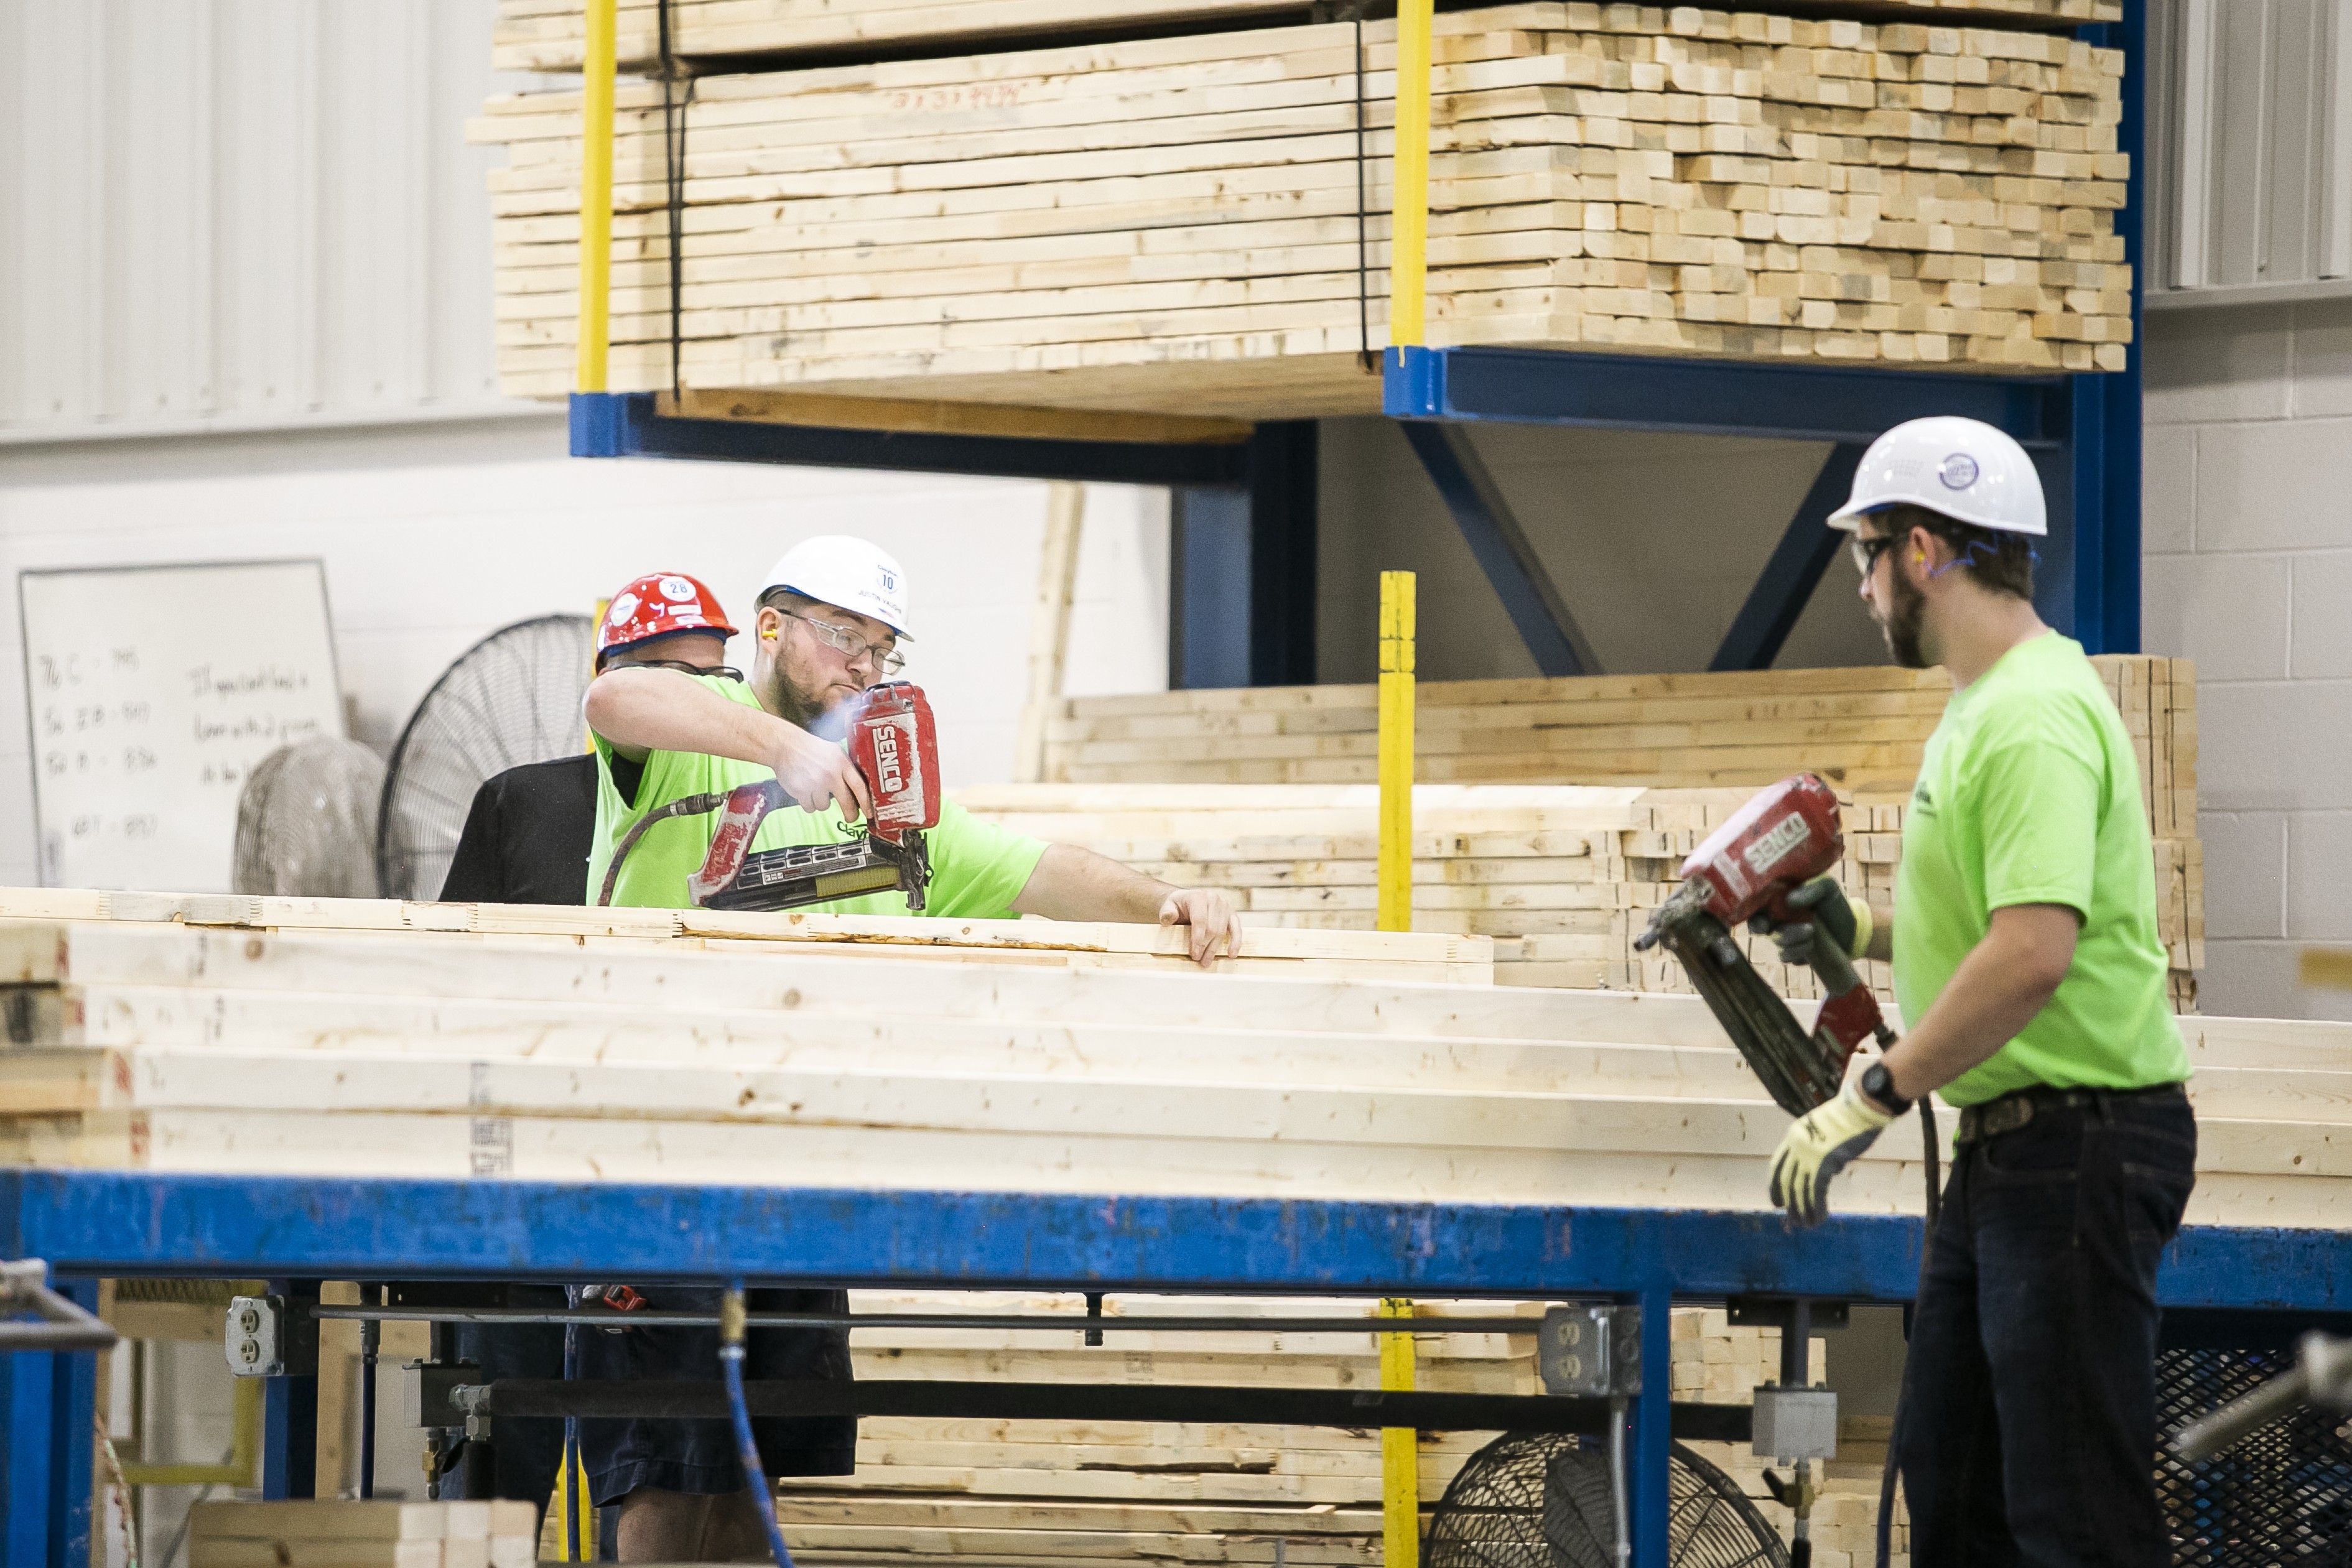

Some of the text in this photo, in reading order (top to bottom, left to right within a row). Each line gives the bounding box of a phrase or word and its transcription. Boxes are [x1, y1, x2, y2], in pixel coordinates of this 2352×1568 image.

[670, 583, 687, 593] 28
[883, 574, 893, 590] 10
[876, 726, 903, 792] SENCO
[837, 821, 868, 841] Clayt
[1744, 810, 1808, 870] SENCO
